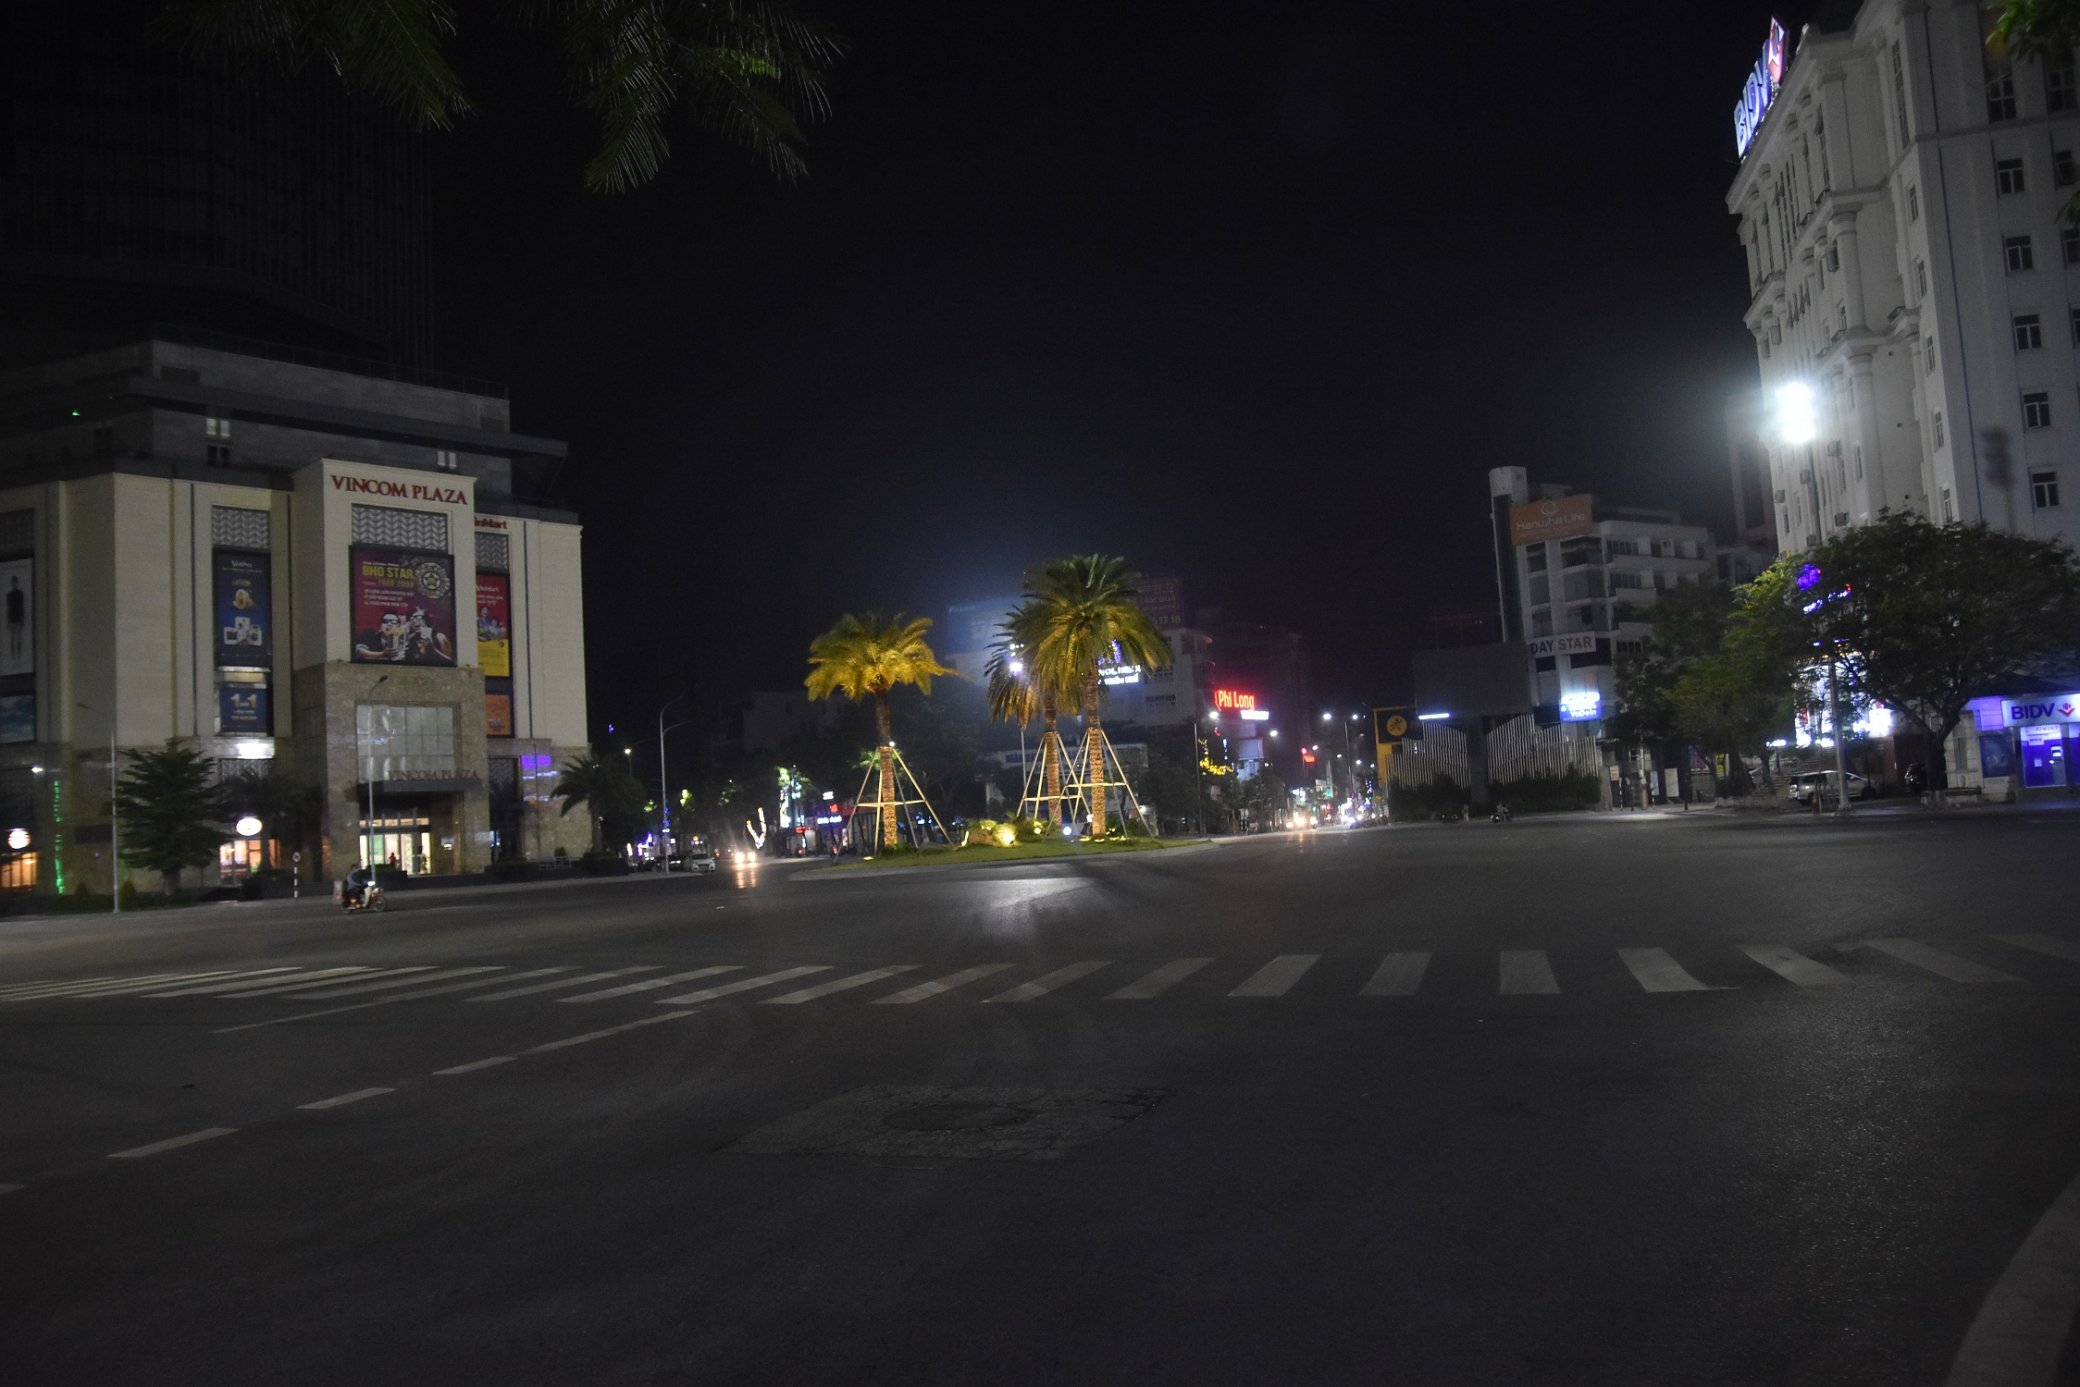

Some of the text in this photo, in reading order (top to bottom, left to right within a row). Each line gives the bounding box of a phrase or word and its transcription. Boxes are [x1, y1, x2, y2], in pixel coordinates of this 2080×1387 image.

[330, 475, 468, 505] VINCOM PLAZA
[362, 565, 414, 580] BHD STAR
[1558, 636, 1593, 651] STAR
[1218, 690, 1255, 712] Phi Long
[2011, 702, 2055, 720] BIDV
